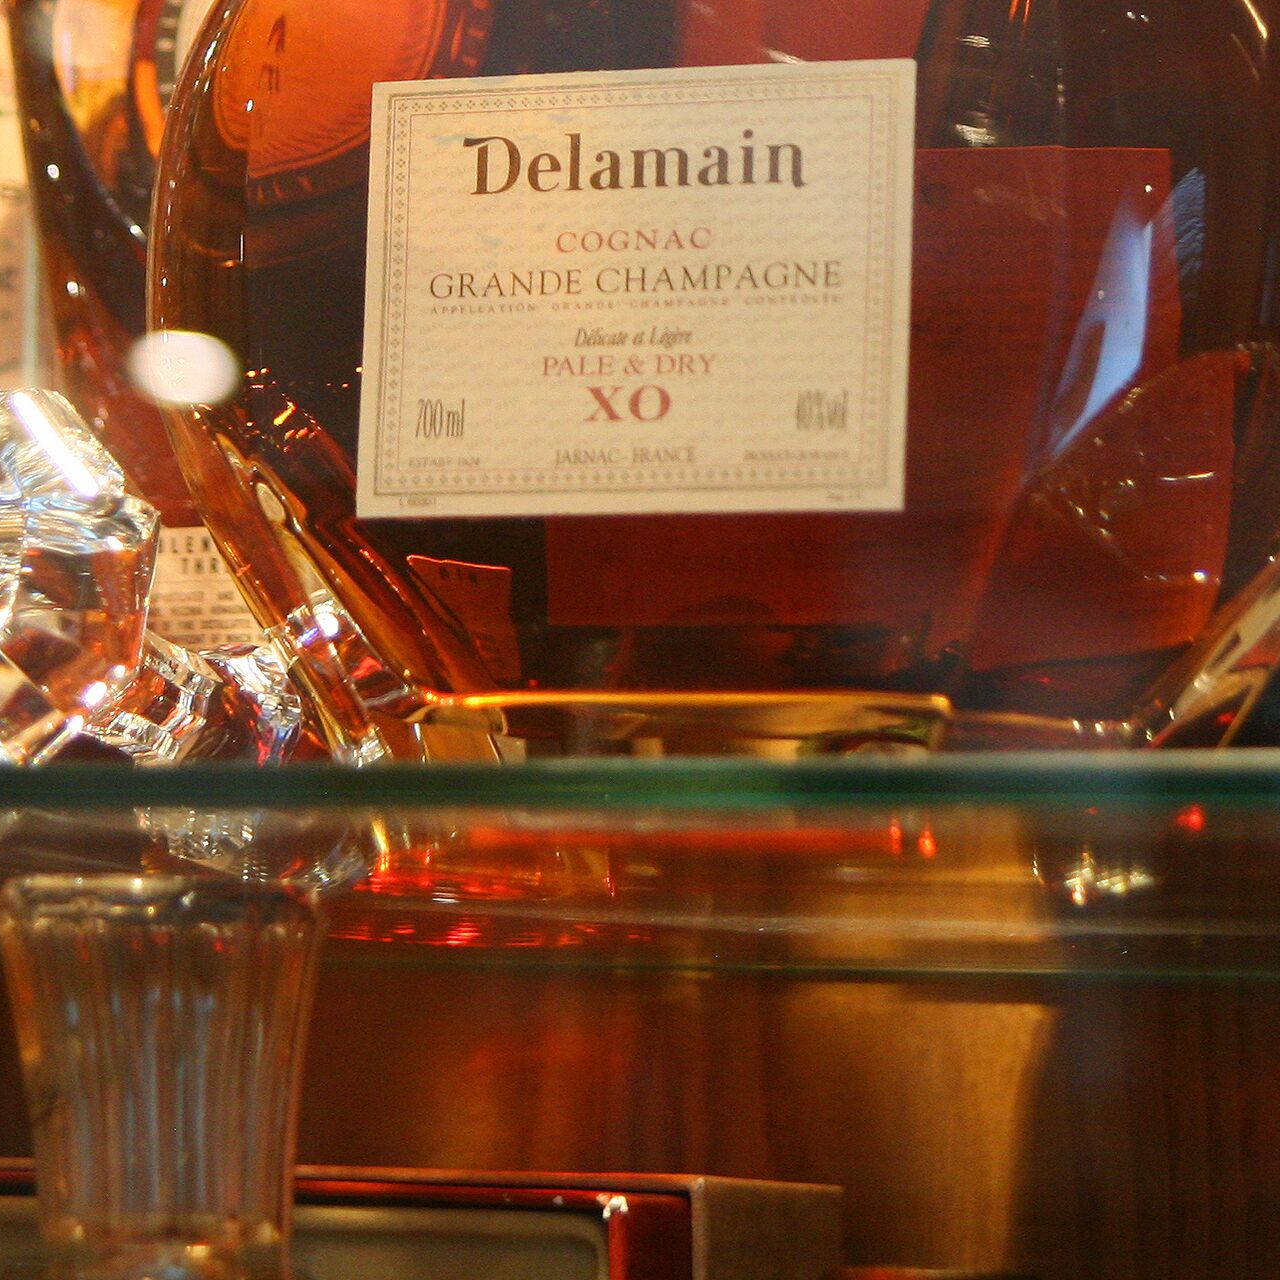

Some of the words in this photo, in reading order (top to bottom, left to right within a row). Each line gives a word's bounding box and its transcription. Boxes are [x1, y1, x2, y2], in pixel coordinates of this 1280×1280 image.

[463, 128, 807, 196] Delamain
[556, 226, 712, 254] COGNAC
[430, 271, 583, 300] GRANDE
[596, 260, 842, 294] CHAMPAGNE
[542, 356, 614, 376] PALE
[623, 354, 642, 375] &
[655, 352, 718, 375] DRY
[415, 398, 443, 438] 700
[584, 384, 673, 422] XO
[555, 447, 621, 466] JARNAC
